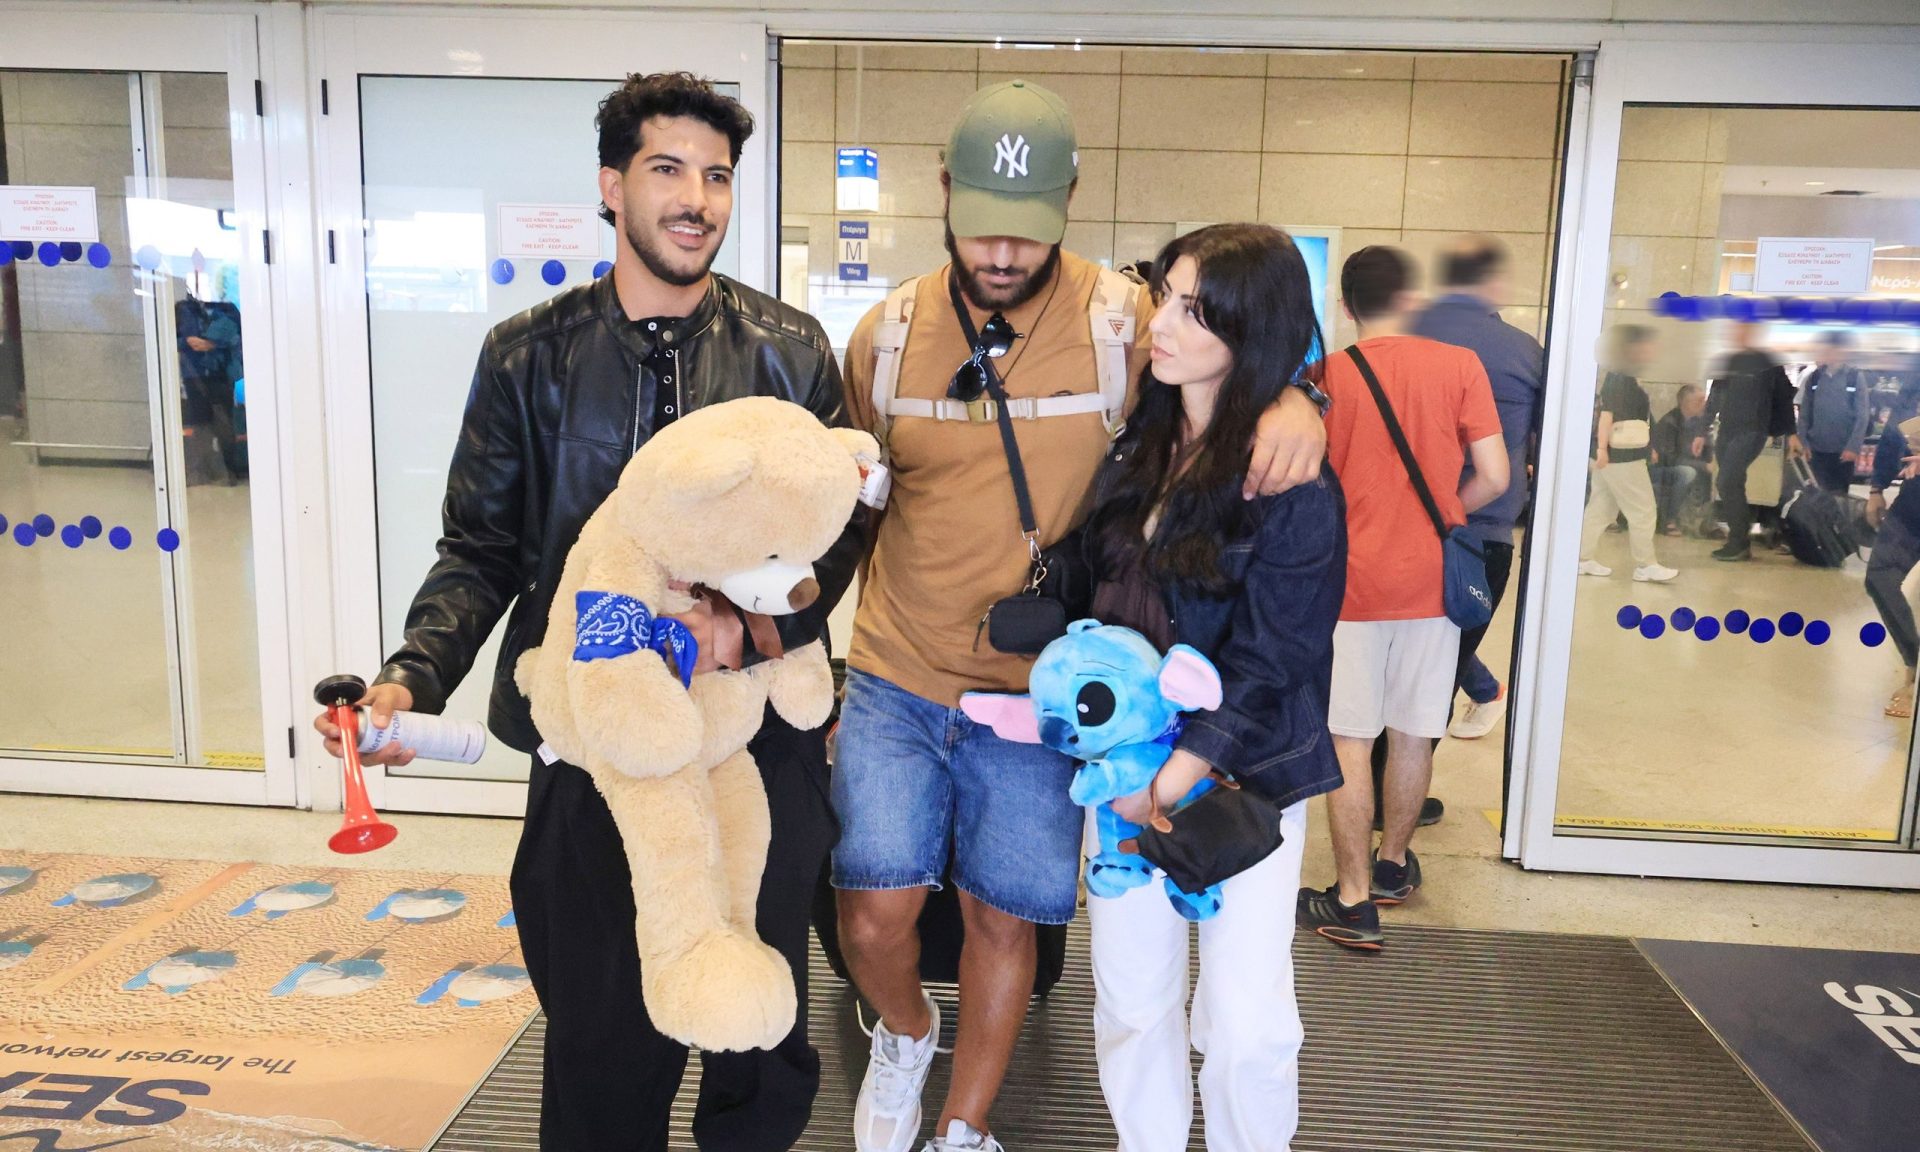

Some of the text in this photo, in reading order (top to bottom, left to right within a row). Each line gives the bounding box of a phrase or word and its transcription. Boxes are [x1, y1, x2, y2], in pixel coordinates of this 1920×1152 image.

[993, 134, 1030, 178] NY
[846, 241, 861, 261] M
[116, 1049, 234, 1071] largest
[243, 1057, 297, 1074] The
